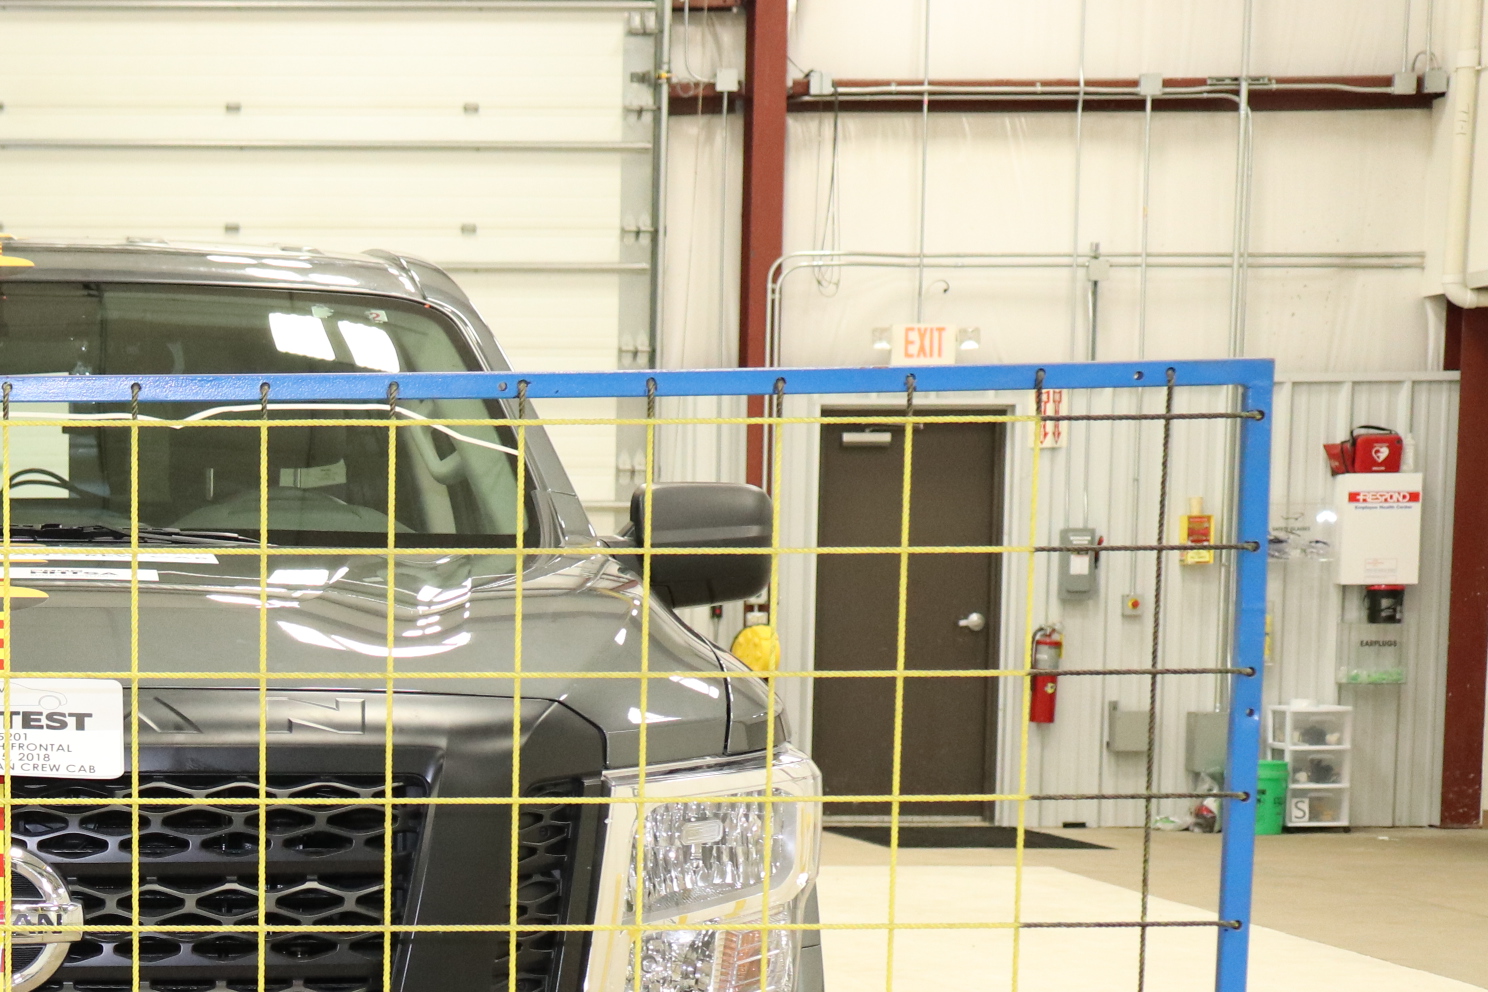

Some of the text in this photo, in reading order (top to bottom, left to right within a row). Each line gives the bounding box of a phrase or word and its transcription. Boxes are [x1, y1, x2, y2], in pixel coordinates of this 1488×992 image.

[903, 326, 946, 358] EXIT
[1358, 491, 1410, 503] RESPOND
[10, 742, 73, 752] FRONTAL
[18, 752, 51, 762] 2018
[20, 763, 61, 772] CREW
[65, 764, 96, 774] CAB
[1293, 800, 1307, 819] S
